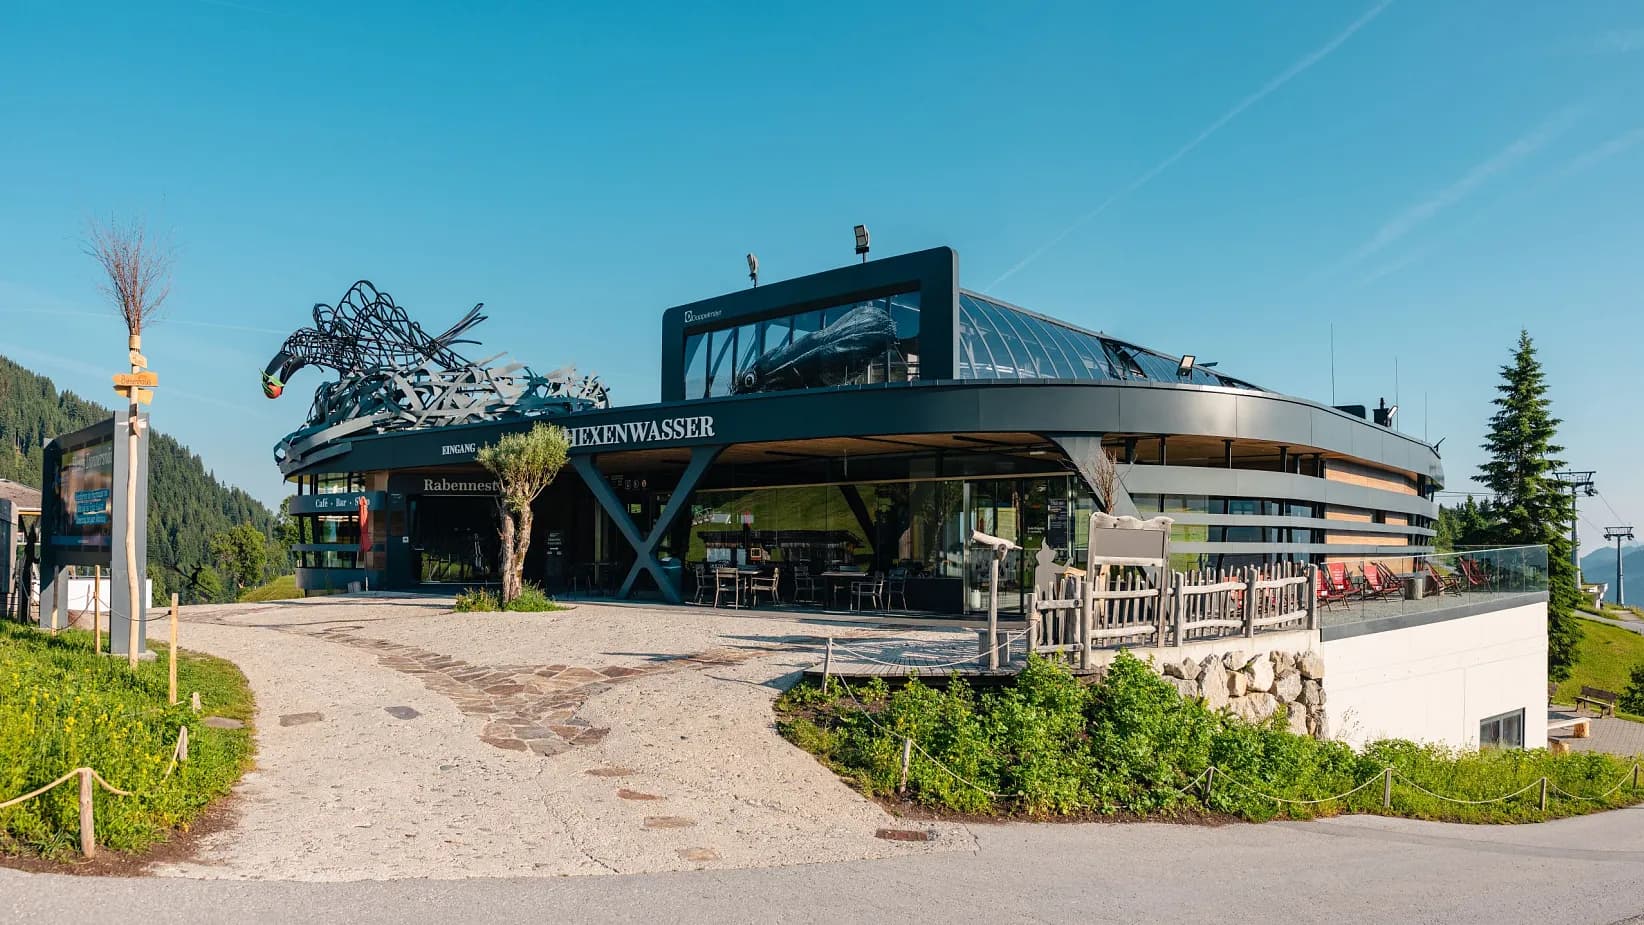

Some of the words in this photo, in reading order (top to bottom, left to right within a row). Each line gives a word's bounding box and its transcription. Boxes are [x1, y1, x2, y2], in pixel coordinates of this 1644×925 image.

[441, 443, 476, 456] EINGANG
[564, 415, 715, 448] HEXENWASSER
[423, 478, 499, 491] Rabennest
[315, 497, 329, 508] Café
[336, 497, 347, 507] Bar
